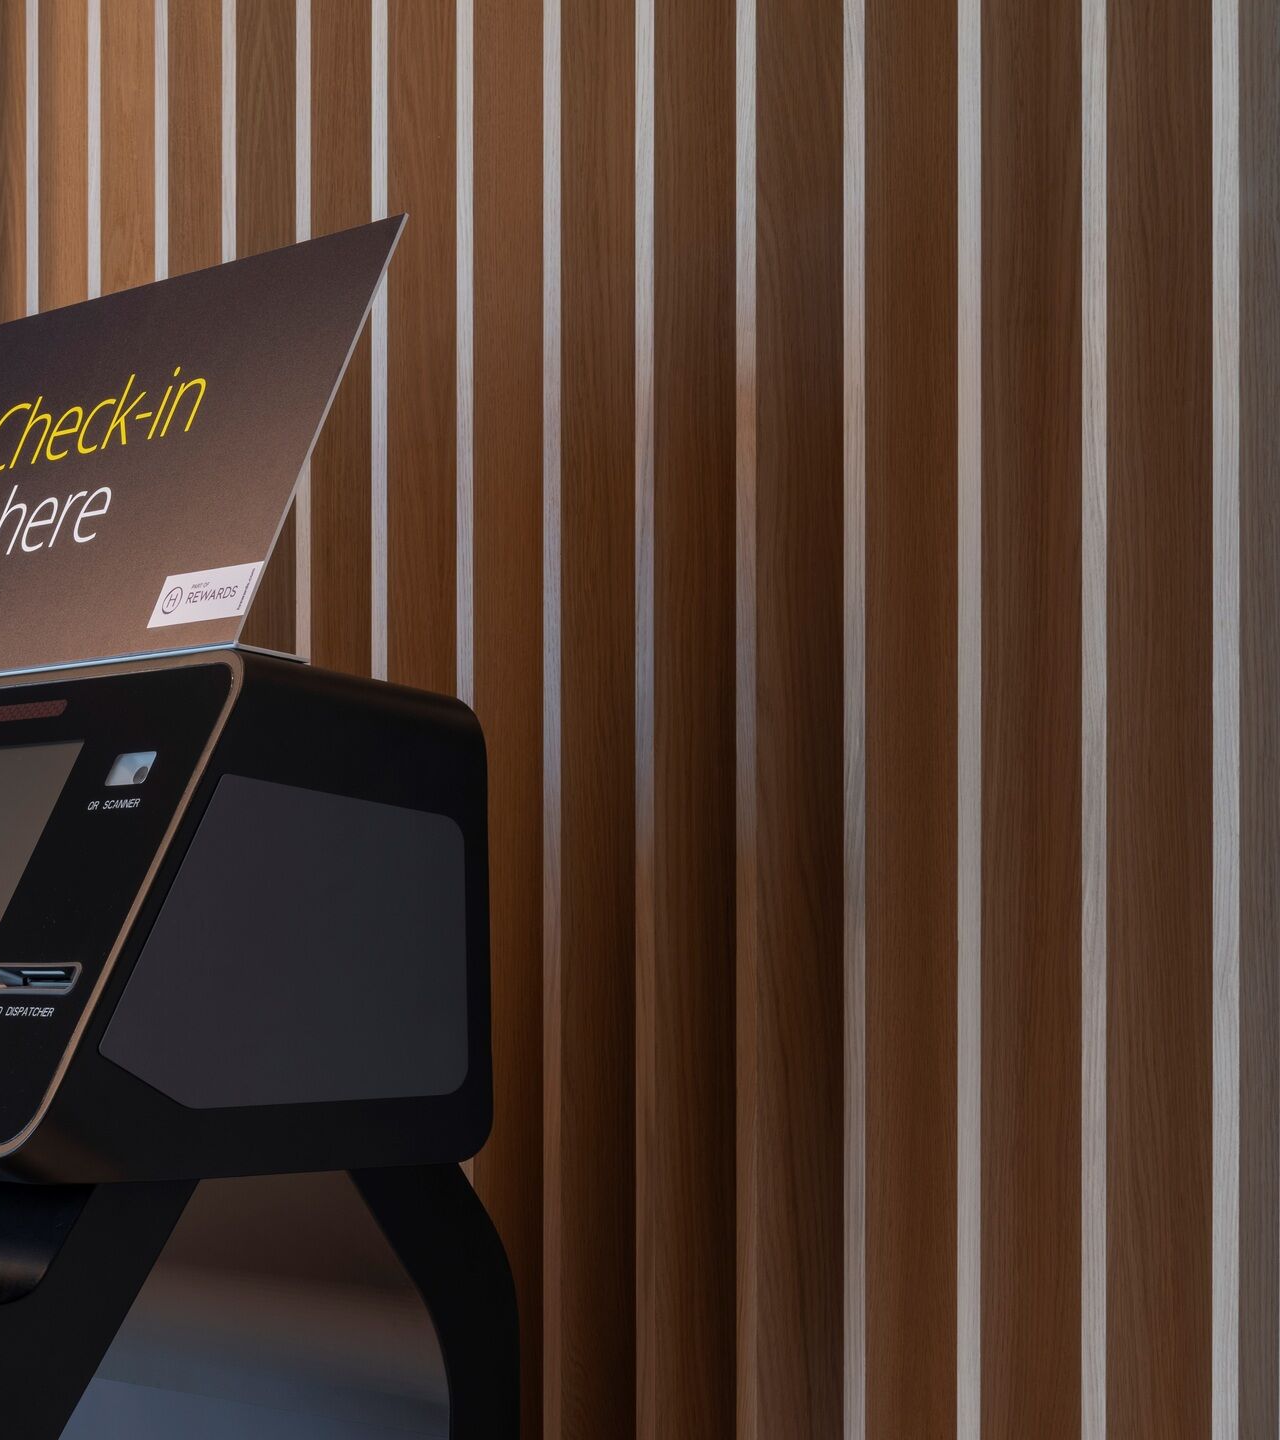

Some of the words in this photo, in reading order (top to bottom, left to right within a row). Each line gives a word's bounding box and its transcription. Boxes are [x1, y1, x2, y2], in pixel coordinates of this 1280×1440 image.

[185, 585, 239, 605] REWARDS
[102, 798, 141, 810] SCANNER
[4, 1006, 55, 1017] DISPATCHER
